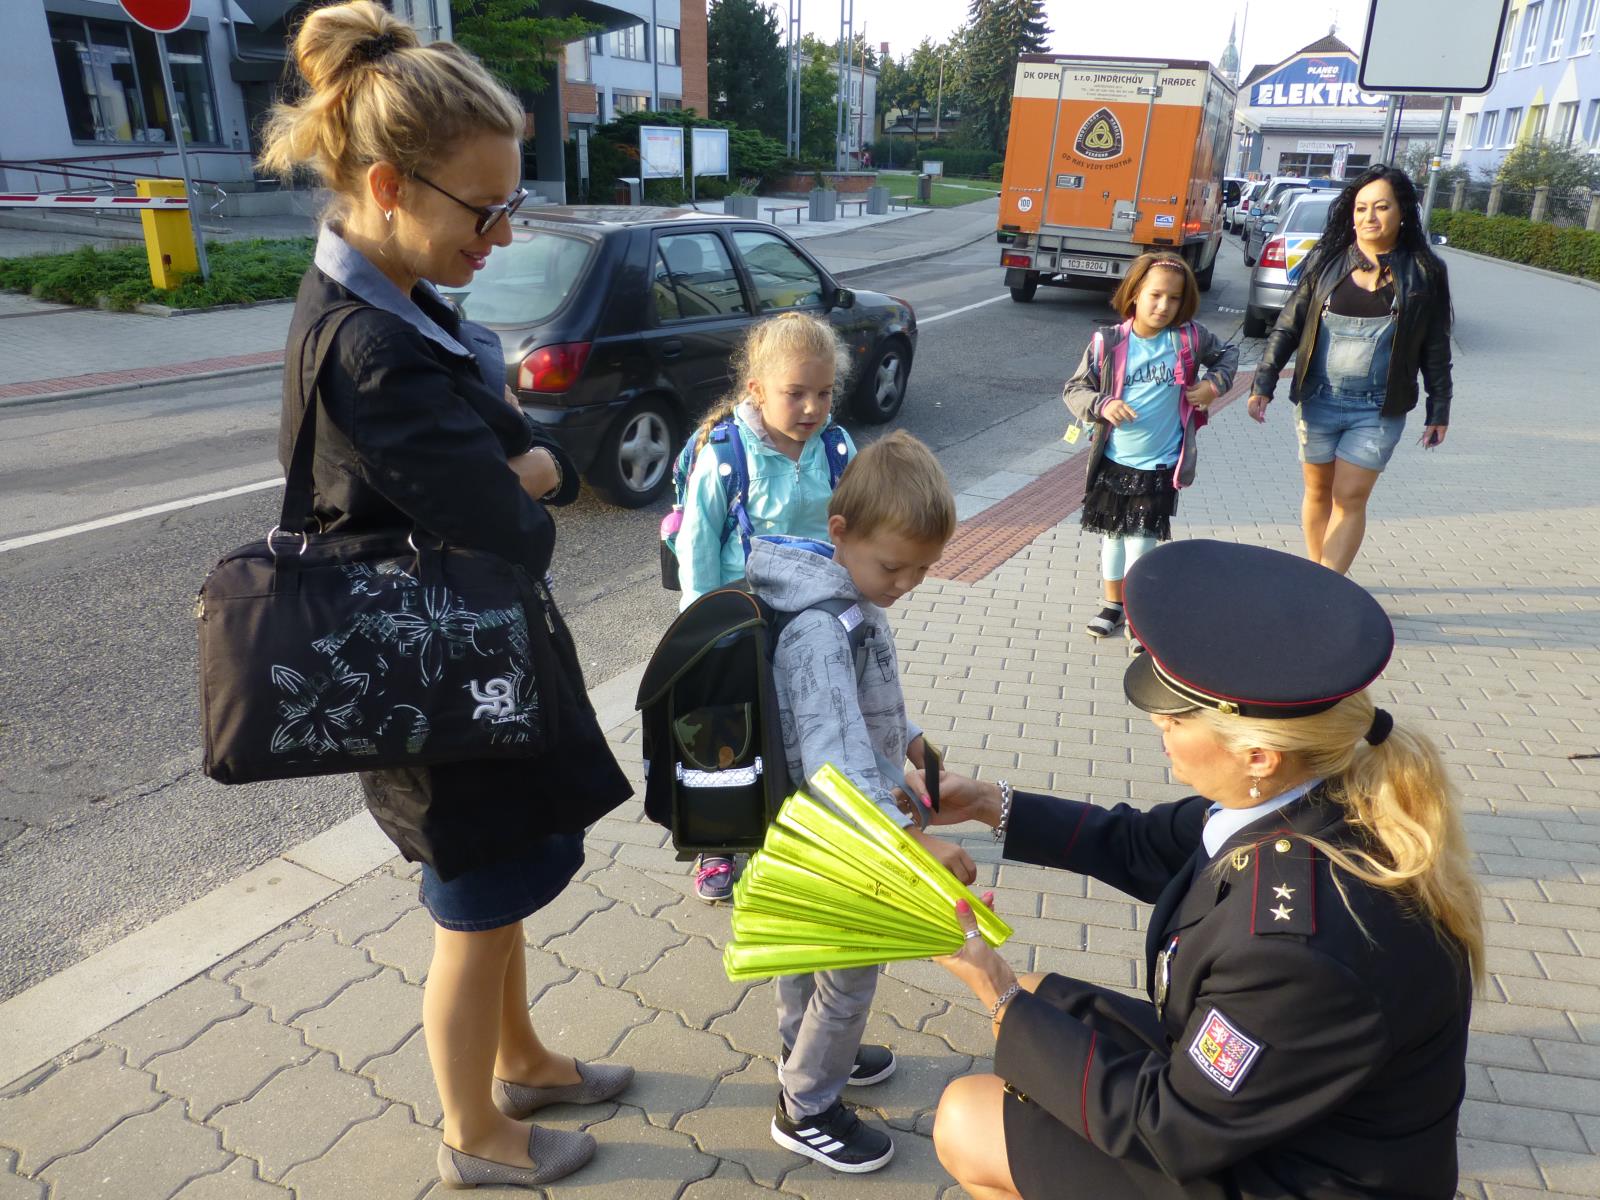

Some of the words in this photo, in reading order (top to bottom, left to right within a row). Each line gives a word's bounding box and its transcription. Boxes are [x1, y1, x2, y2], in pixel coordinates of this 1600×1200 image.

[1307, 66, 1339, 75] PLANEO
[1023, 71, 1035, 79] DK
[1161, 77, 1197, 87] HRADEC
[1020, 199, 1031, 208] 100
[1192, 1047, 1232, 1087] POLICIE
